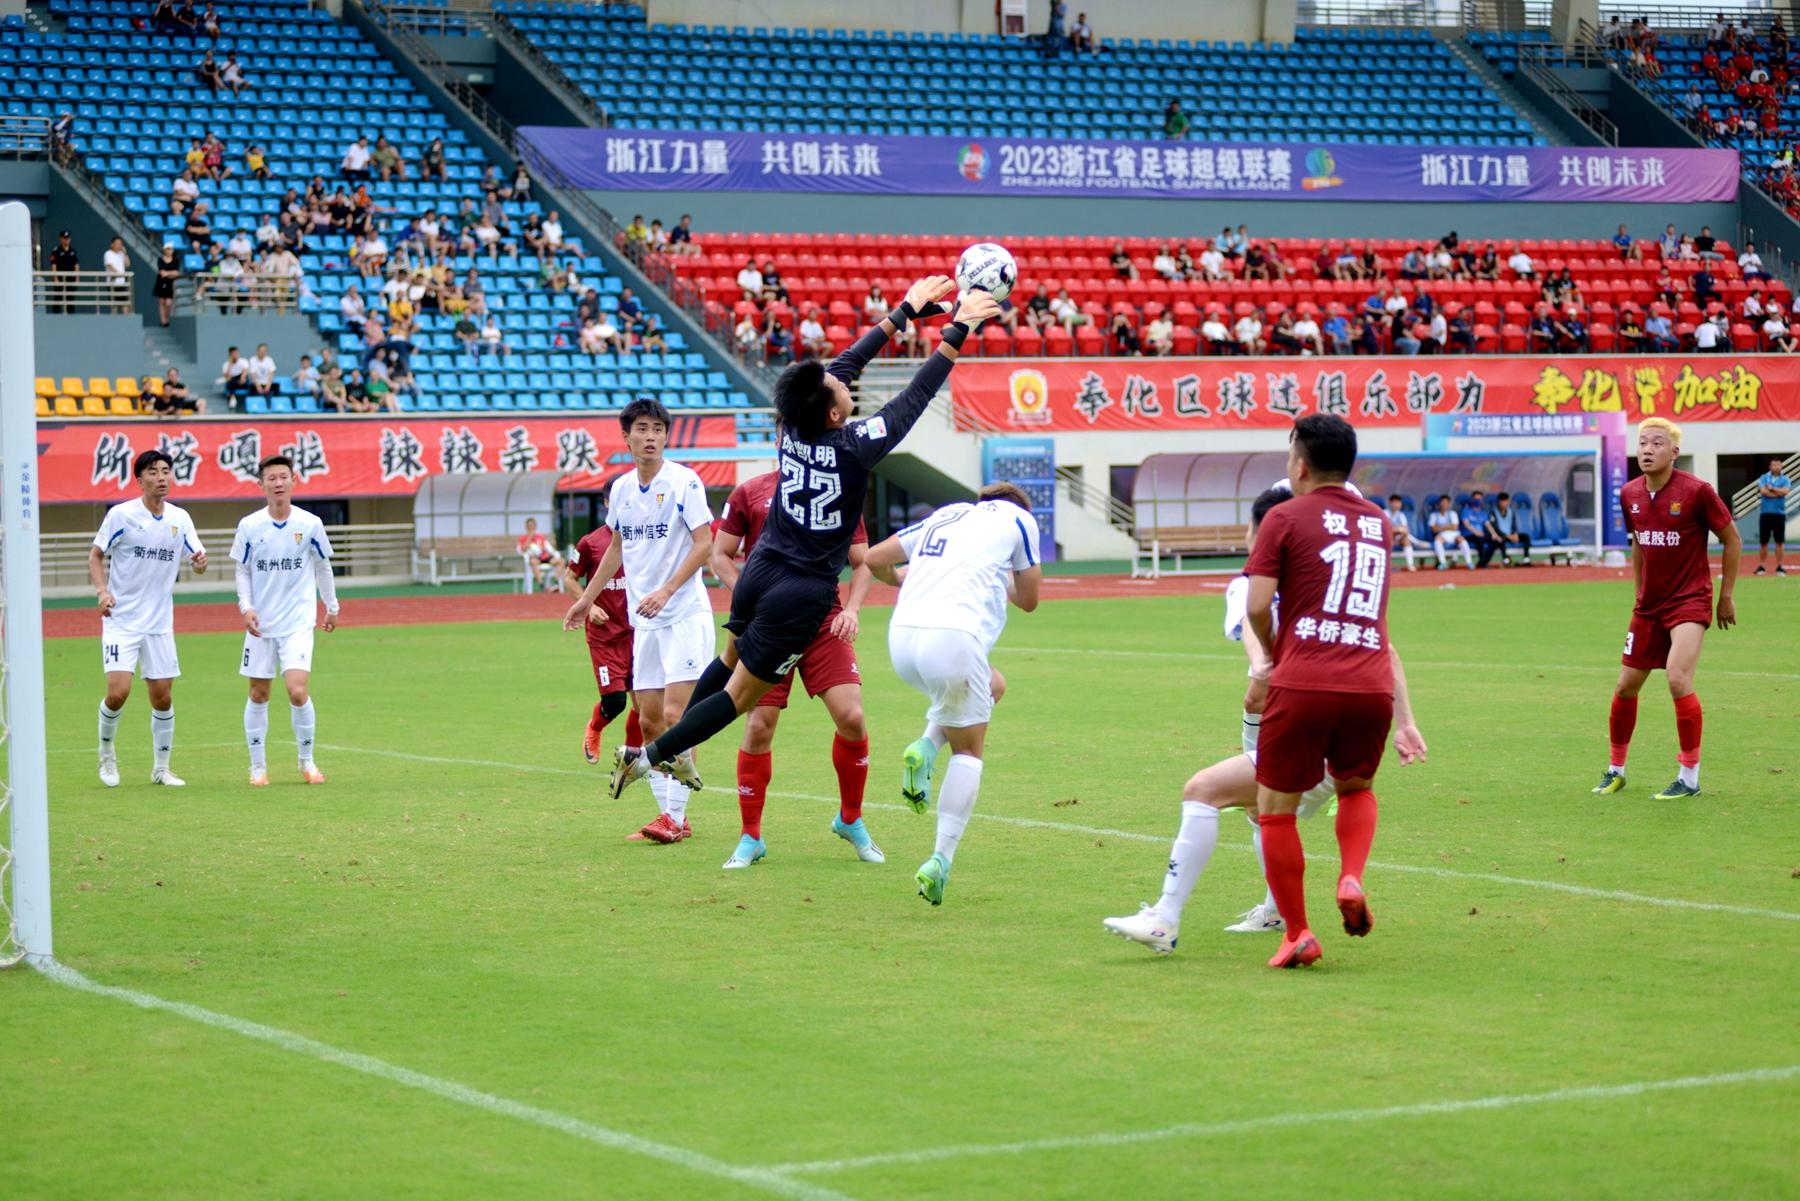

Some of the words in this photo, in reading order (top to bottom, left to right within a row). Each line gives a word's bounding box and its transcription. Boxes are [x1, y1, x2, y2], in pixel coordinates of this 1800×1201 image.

[606, 139, 729, 175] 浙江力量
[762, 140, 882, 177] 共创未来
[999, 144, 1292, 181] 2023浙江省足球超级联赛
[1421, 153, 1531, 187] 浙江力量
[1559, 155, 1666, 187] 共创未来
[1001, 177, 1084, 188] ZHEJIANG
[1086, 178, 1169, 189] FOOTBALL
[1172, 180, 1226, 190] SUPER
[1228, 180, 1292, 191] LEAGUE
[1673, 364, 1762, 415] 加油
[781, 454, 842, 530] 22
[622, 522, 669, 541] 衢州信安
[918, 509, 970, 557] 2
[1322, 510, 1384, 541] 权恒
[1634, 529, 1681, 546] 威股份
[134, 546, 175, 562] 衢州信安
[256, 558, 303, 572] 衢州信安
[1319, 540, 1387, 621] 19
[1295, 617, 1381, 650] 华侨豪生
[105, 644, 119, 664] 24
